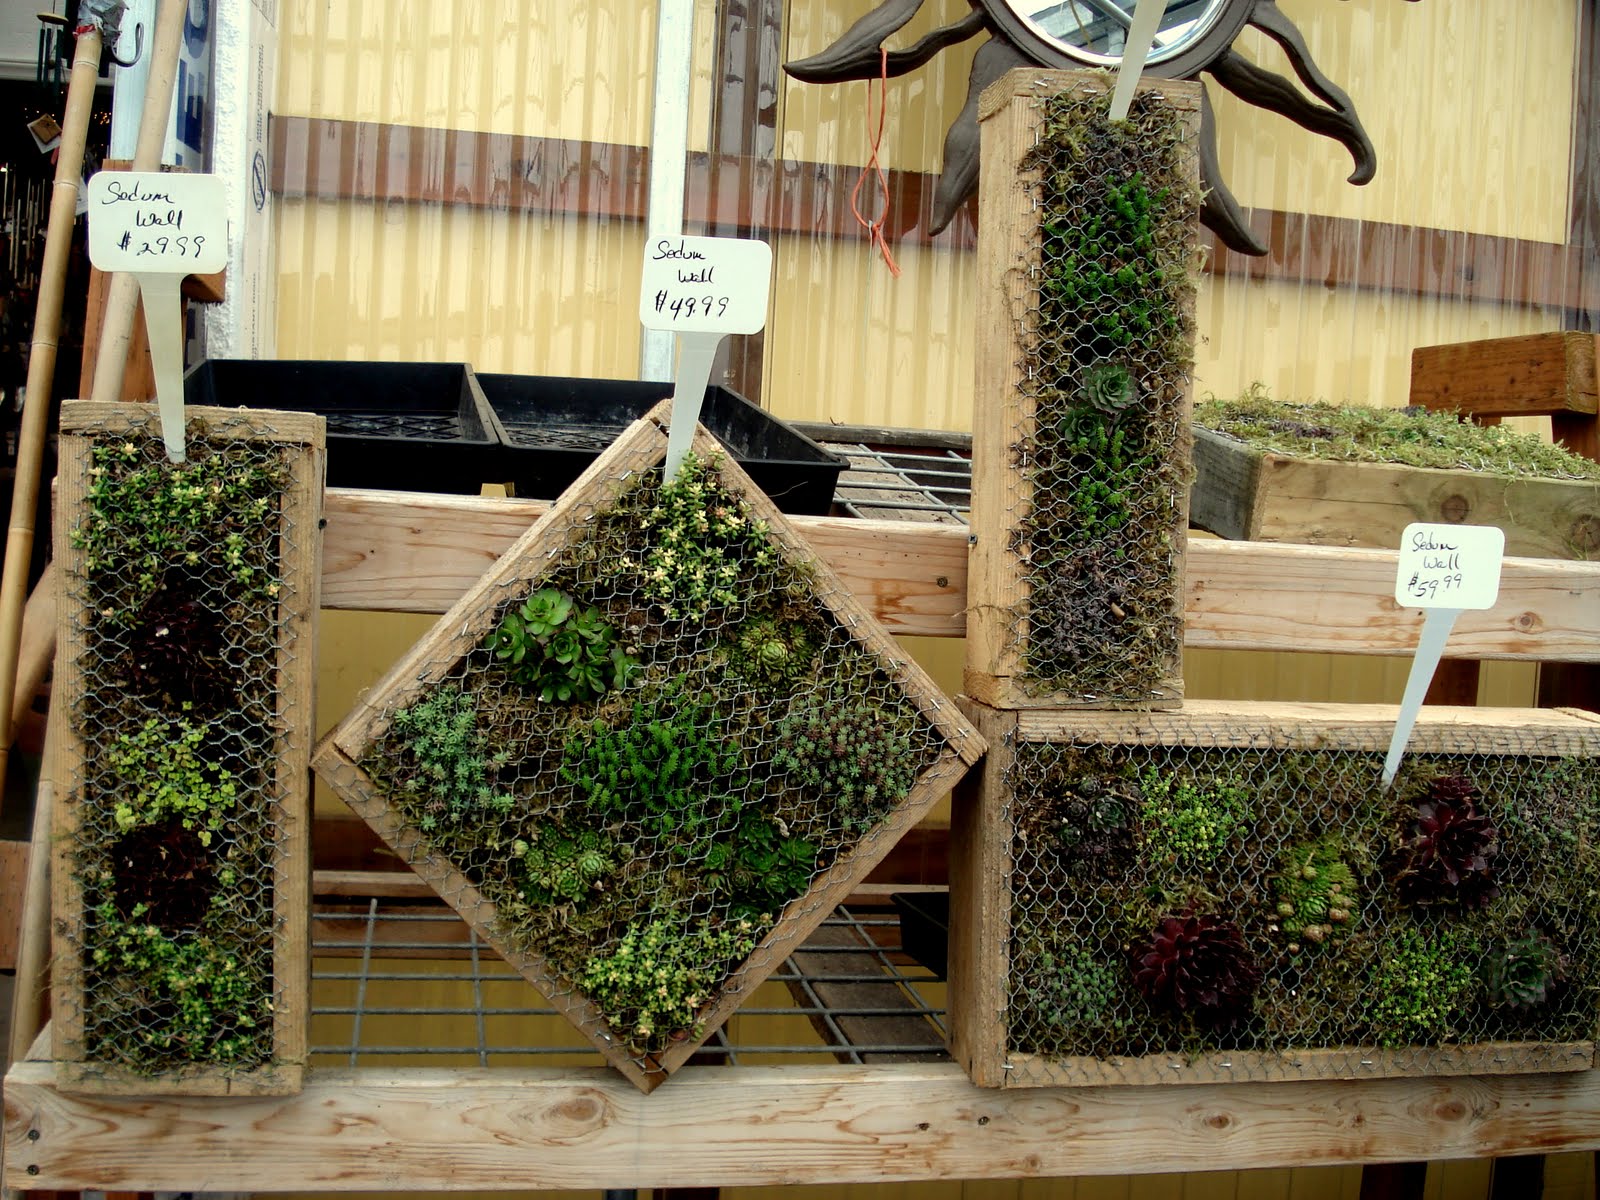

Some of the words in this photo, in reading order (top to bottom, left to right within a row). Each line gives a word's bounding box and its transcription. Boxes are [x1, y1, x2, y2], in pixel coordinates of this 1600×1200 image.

[136, 210, 183, 230] Wall
[653, 240, 706, 260] Sedum
[655, 289, 729, 320] $49.99
[1412, 532, 1458, 552] Sedum
[1423, 553, 1460, 570] Wall
[1408, 572, 1463, 599] $59.99
